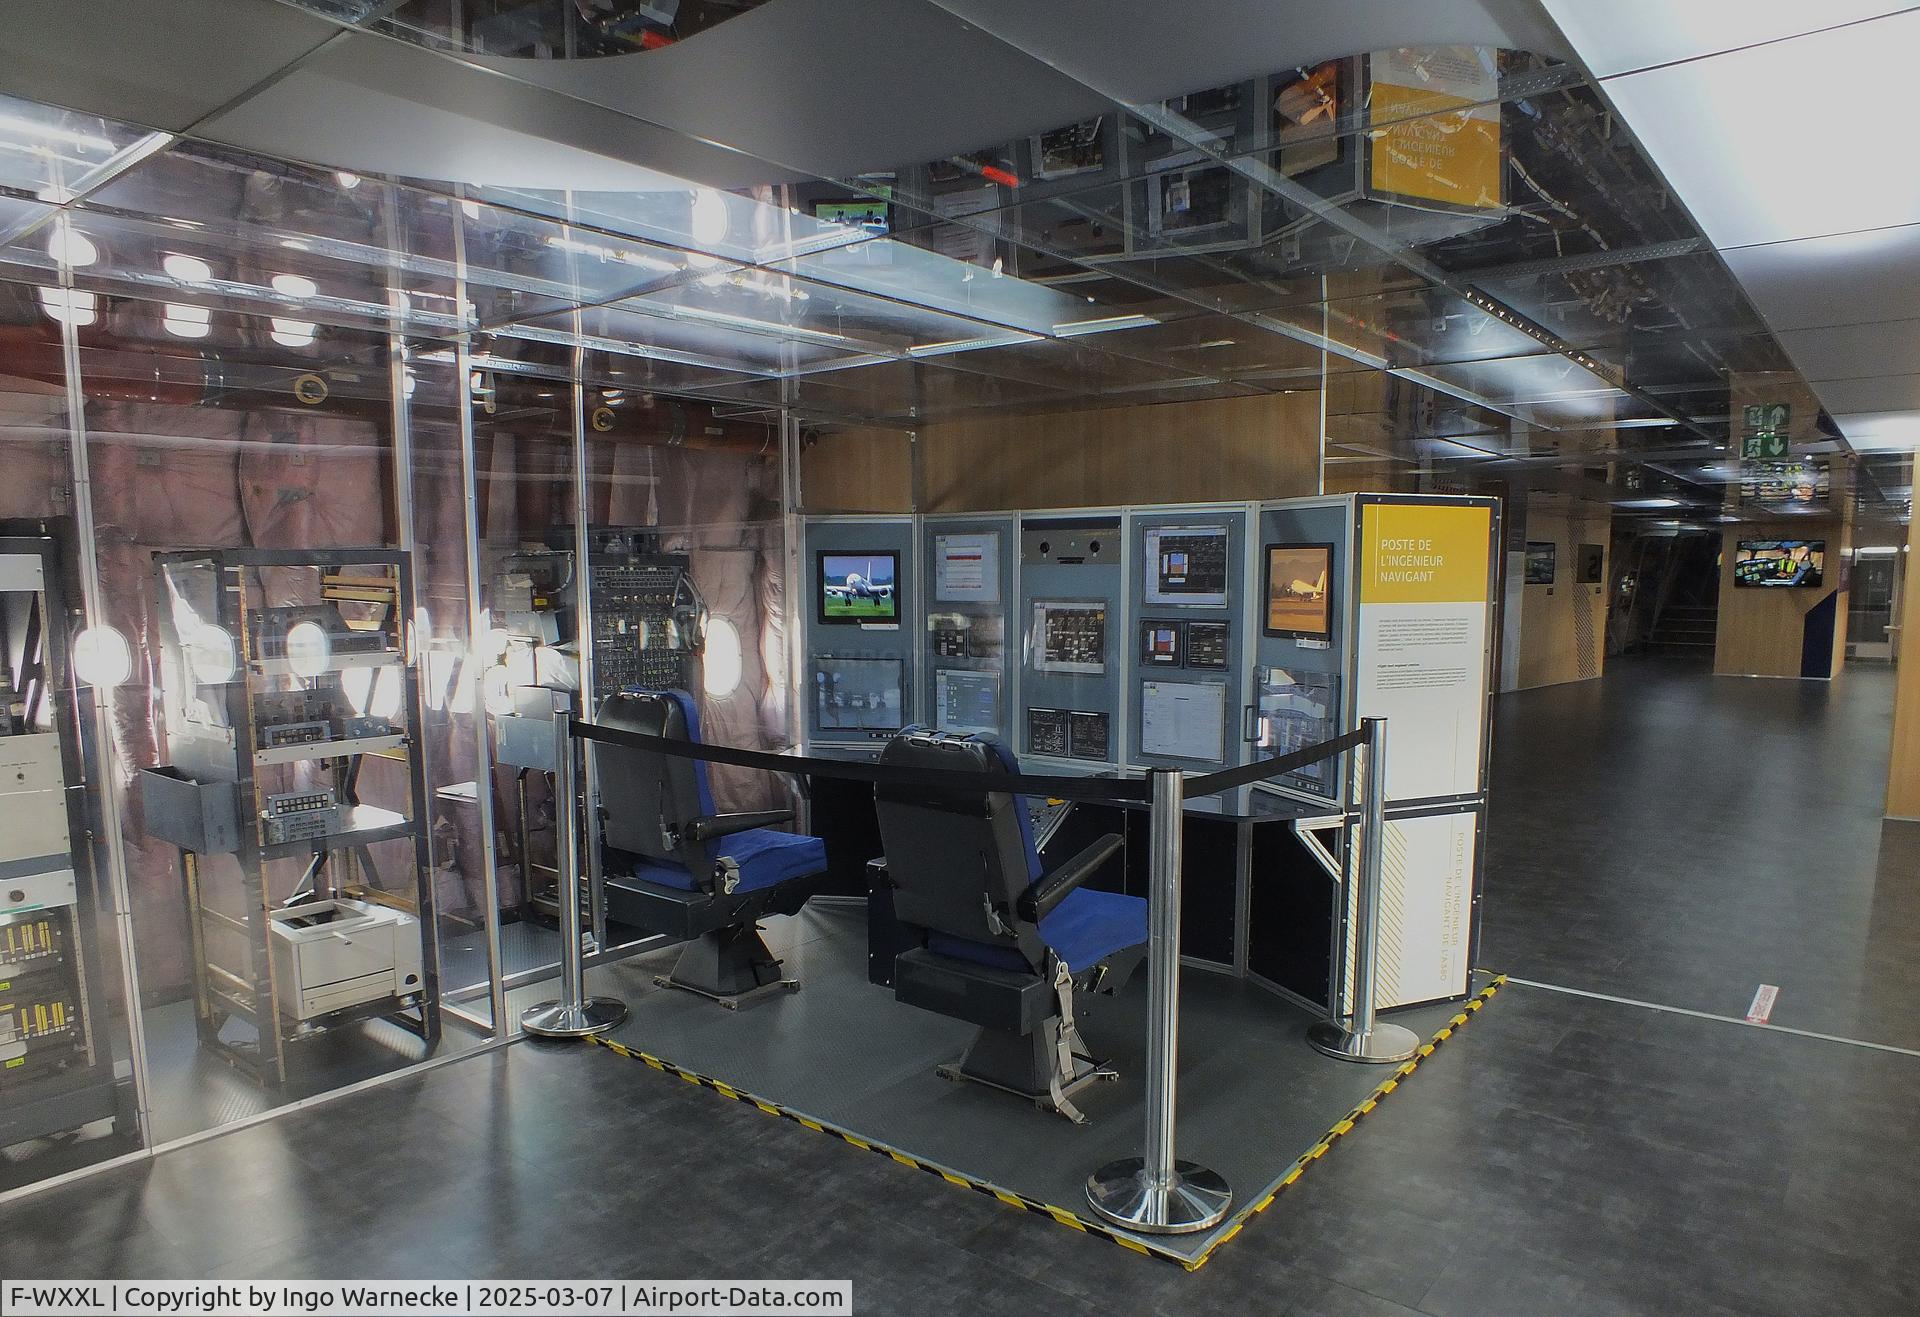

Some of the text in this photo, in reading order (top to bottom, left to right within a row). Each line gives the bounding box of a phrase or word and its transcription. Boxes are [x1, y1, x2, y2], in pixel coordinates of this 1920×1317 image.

[1381, 539, 1432, 551] POSTE DE
[1380, 551, 1443, 567] L'INGÉNIEUR
[1380, 571, 1434, 582] NAVIGANT
